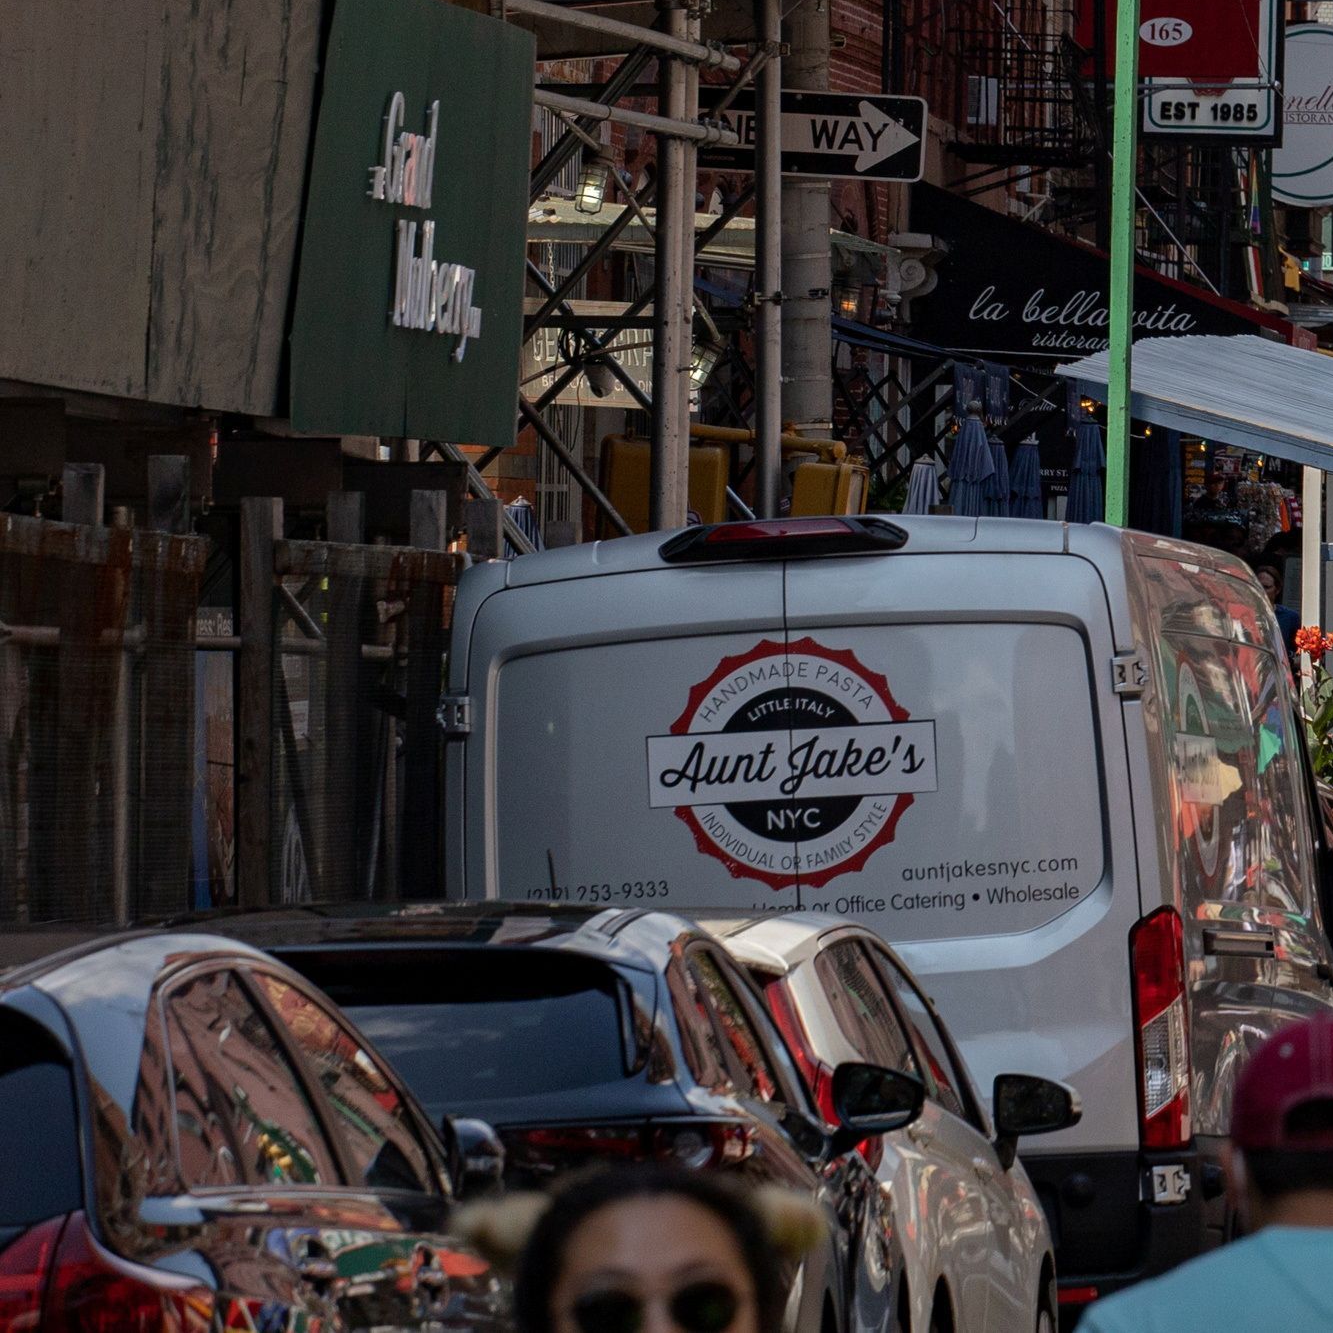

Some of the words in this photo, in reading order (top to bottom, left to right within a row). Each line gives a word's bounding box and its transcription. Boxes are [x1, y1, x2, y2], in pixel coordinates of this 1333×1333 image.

[1150, 23, 1183, 41] 165
[1160, 101, 1200, 120] EST
[1211, 103, 1258, 122] 1985
[810, 119, 889, 152] WAY
[969, 286, 1009, 320] la
[1023, 289, 1110, 326] bella
[1131, 301, 1197, 332] vita
[1033, 330, 1110, 350] ristoran
[700, 662, 808, 722] HANDMADE
[815, 664, 872, 711] PASTA
[747, 698, 792, 722] LITTLE
[796, 698, 835, 719] ITALY
[660, 741, 776, 793] Aunt
[780, 734, 925, 795] Jake's
[767, 807, 821, 831] NYC
[701, 811, 774, 869] INDIVIDUAL
[806, 838, 854, 869] FAMILY
[853, 801, 888, 842] STYLE
[902, 855, 1078, 883] auntjakesnyc.com
[577, 880, 669, 902] 253-9333
[835, 896, 885, 914] Office
[891, 891, 965, 911] Catering
[987, 883, 1079, 905] Wholesale
